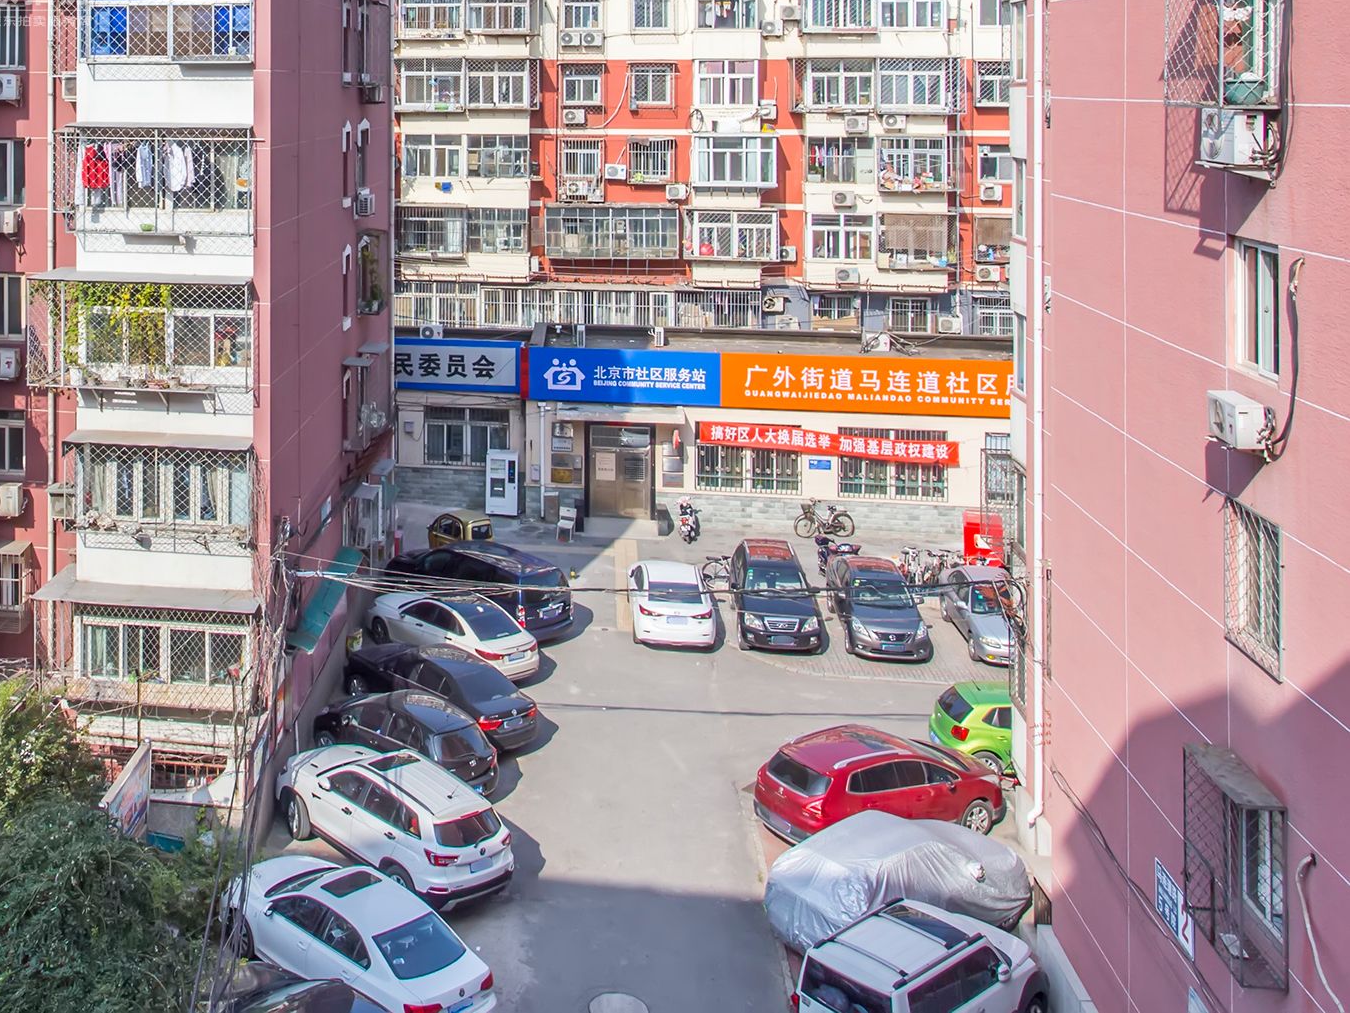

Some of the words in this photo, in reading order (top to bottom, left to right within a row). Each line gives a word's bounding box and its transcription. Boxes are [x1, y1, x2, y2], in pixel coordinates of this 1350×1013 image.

[394, 352, 496, 379] 民委员会
[593, 365, 706, 383] 北京市社区服务站
[593, 379, 617, 387] BEIJING
[618, 380, 654, 388] COMMUNITY
[655, 381, 680, 389] SERVICE
[681, 382, 706, 390] CENTER
[744, 389, 843, 401] GUANGWAIJIEDAO
[847, 393, 912, 402] MALIANDAO
[917, 395, 985, 405] COMMUNITY
[710, 425, 831, 449] 搞好区人大换届选举
[839, 436, 949, 459] 加强基层政权建设
